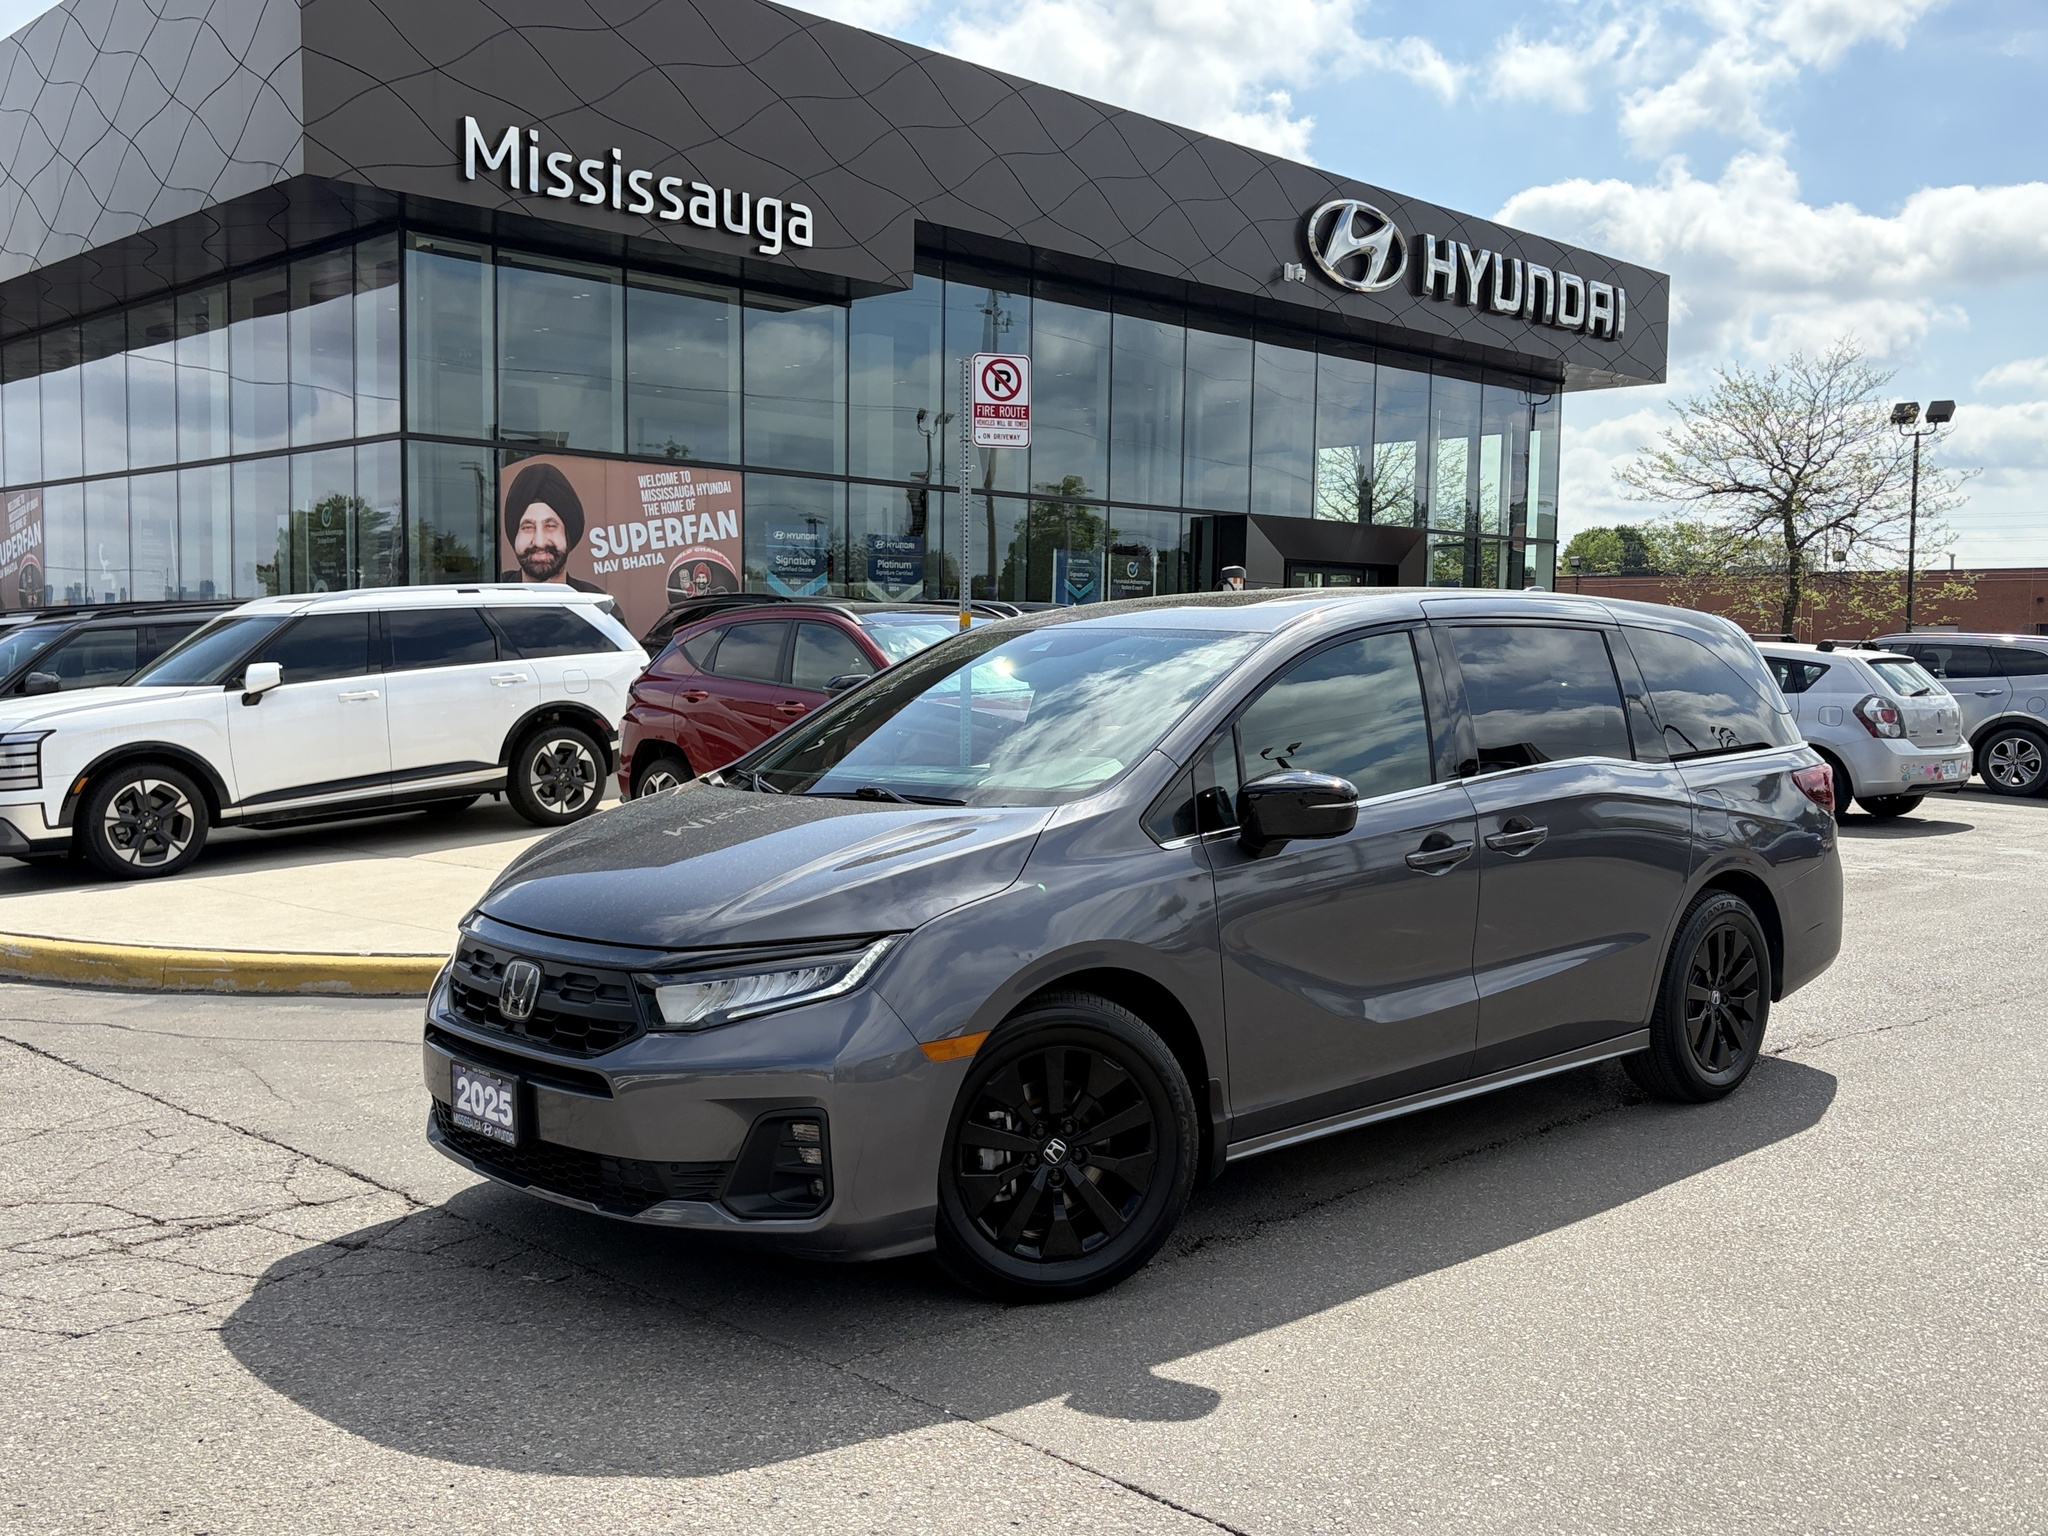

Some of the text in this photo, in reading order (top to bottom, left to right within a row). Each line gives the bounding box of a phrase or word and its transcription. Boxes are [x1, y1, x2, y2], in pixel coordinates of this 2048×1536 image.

[465, 115, 813, 255] Mississauga
[1421, 233, 1626, 341] HYUNDAI
[976, 405, 1027, 418] FIRE ROUTE
[638, 470, 691, 488] WELCOME TO
[641, 481, 732, 502] MISSISSAUGA HYUNDAI
[642, 498, 696, 517] THE HOME OF
[589, 509, 739, 558] SUPERFAN
[886, 541, 916, 549] HYUNDAI
[593, 552, 665, 575] NAV BHATIA
[775, 555, 816, 566] Signature
[877, 560, 912, 569] Platinum
[1689, 901, 1733, 942] TURANZA
[457, 1076, 513, 1127] 2025
